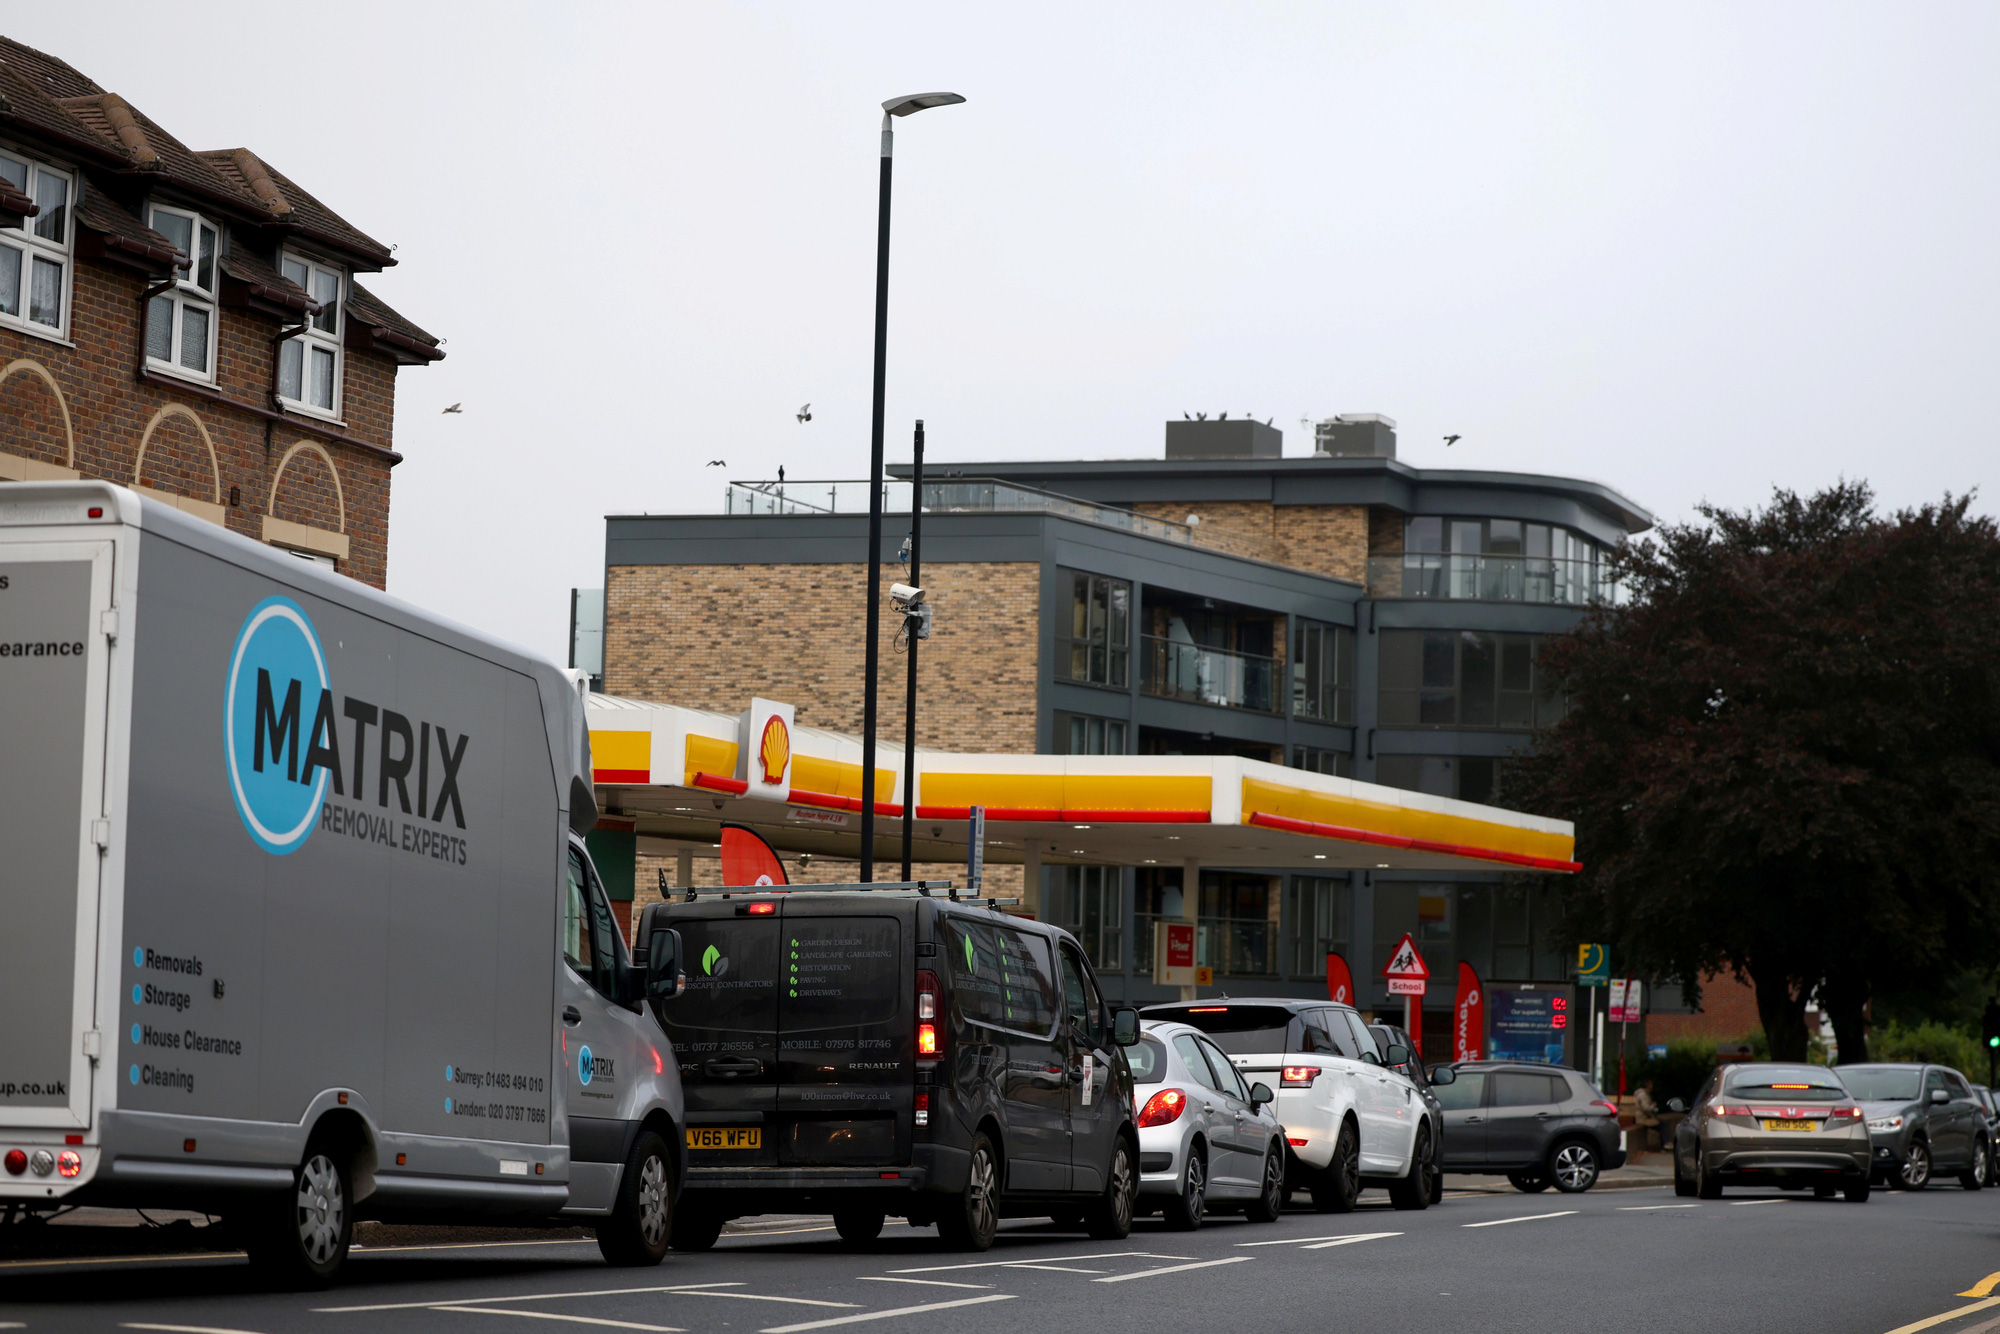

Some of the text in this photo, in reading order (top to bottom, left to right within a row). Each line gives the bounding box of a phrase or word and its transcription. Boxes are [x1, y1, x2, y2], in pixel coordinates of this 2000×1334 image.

[0, 641, 84, 657] earance
[253, 666, 469, 830] MATRIX
[795, 809, 816, 819] Maximum
[322, 802, 467, 866] REMOVAL EXPERTS
[800, 938, 862, 947] GARDEN DESIGN
[800, 950, 892, 959] LANDSCAPE GARDENING
[146, 948, 203, 976] Removals
[800, 964, 851, 972] RESTORATION
[717, 980, 773, 988] CONTRACTORS
[800, 976, 826, 984] PAVING
[1392, 982, 1422, 991] School
[144, 983, 191, 1012] Storage
[799, 988, 842, 997] DRIVEWAYS
[143, 1025, 242, 1056] House Clearance
[692, 1042, 718, 1052] 01737
[721, 1041, 754, 1051] 216556
[781, 1039, 891, 1049] MOBILE: 07976 817746
[582, 1056, 614, 1077] MATRIX
[849, 1062, 900, 1070] RENAULT
[142, 1064, 194, 1093] Cleaning
[455, 1067, 543, 1092] Surrey: 01483 494 010
[454, 1099, 546, 1123] London: 020 3797 7866
[727, 1130, 758, 1146] WFU
